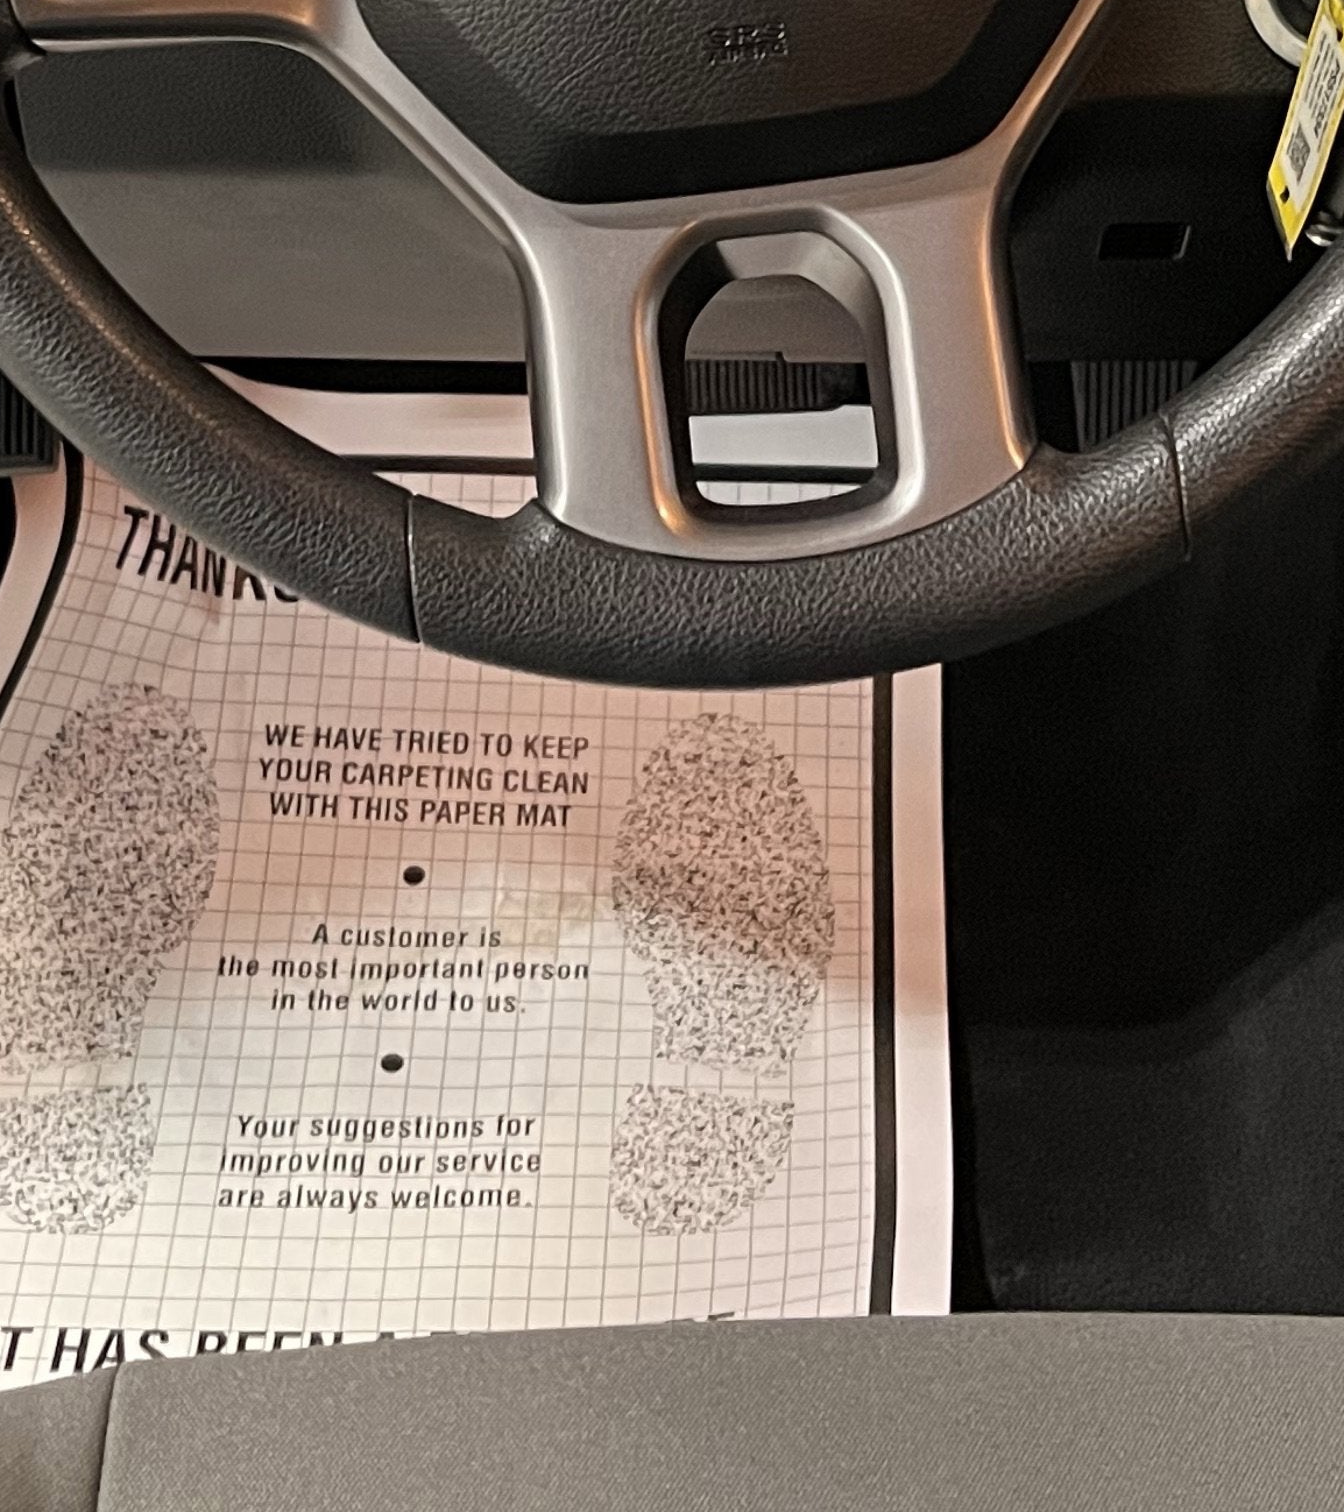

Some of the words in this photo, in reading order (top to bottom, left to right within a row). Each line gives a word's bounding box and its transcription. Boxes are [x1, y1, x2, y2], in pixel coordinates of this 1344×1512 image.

[115, 504, 299, 603] THANK
[265, 724, 306, 749] WE
[312, 726, 383, 752] HAVE
[391, 729, 469, 756] TRIED
[480, 732, 513, 757] TO
[523, 734, 590, 760] KEEP
[259, 757, 332, 784] YOUR
[341, 761, 494, 793] CARPETING
[502, 769, 590, 795] CLEAN
[269, 791, 339, 819] WITH
[349, 795, 409, 823] THIS
[419, 799, 506, 827] PAPER
[515, 803, 573, 828] MAT
[311, 923, 329, 946] A
[340, 926, 469, 949] customer
[479, 926, 502, 948] is
[218, 955, 260, 978] the
[271, 958, 339, 979] most
[349, 958, 484, 983] important
[494, 962, 590, 983] person
[270, 988, 296, 1012] in
[307, 988, 350, 1012] the
[361, 990, 438, 1013] world
[449, 990, 474, 1013] to
[486, 995, 527, 1014] us.
[237, 1114, 299, 1140] Your
[309, 1115, 485, 1144] suggestions
[496, 1114, 537, 1138] for
[219, 1149, 366, 1178] improving
[377, 1153, 425, 1175] our
[436, 1152, 542, 1174] service
[218, 1188, 264, 1209] are
[276, 1183, 379, 1215] always
[390, 1185, 533, 1209] welcome.
